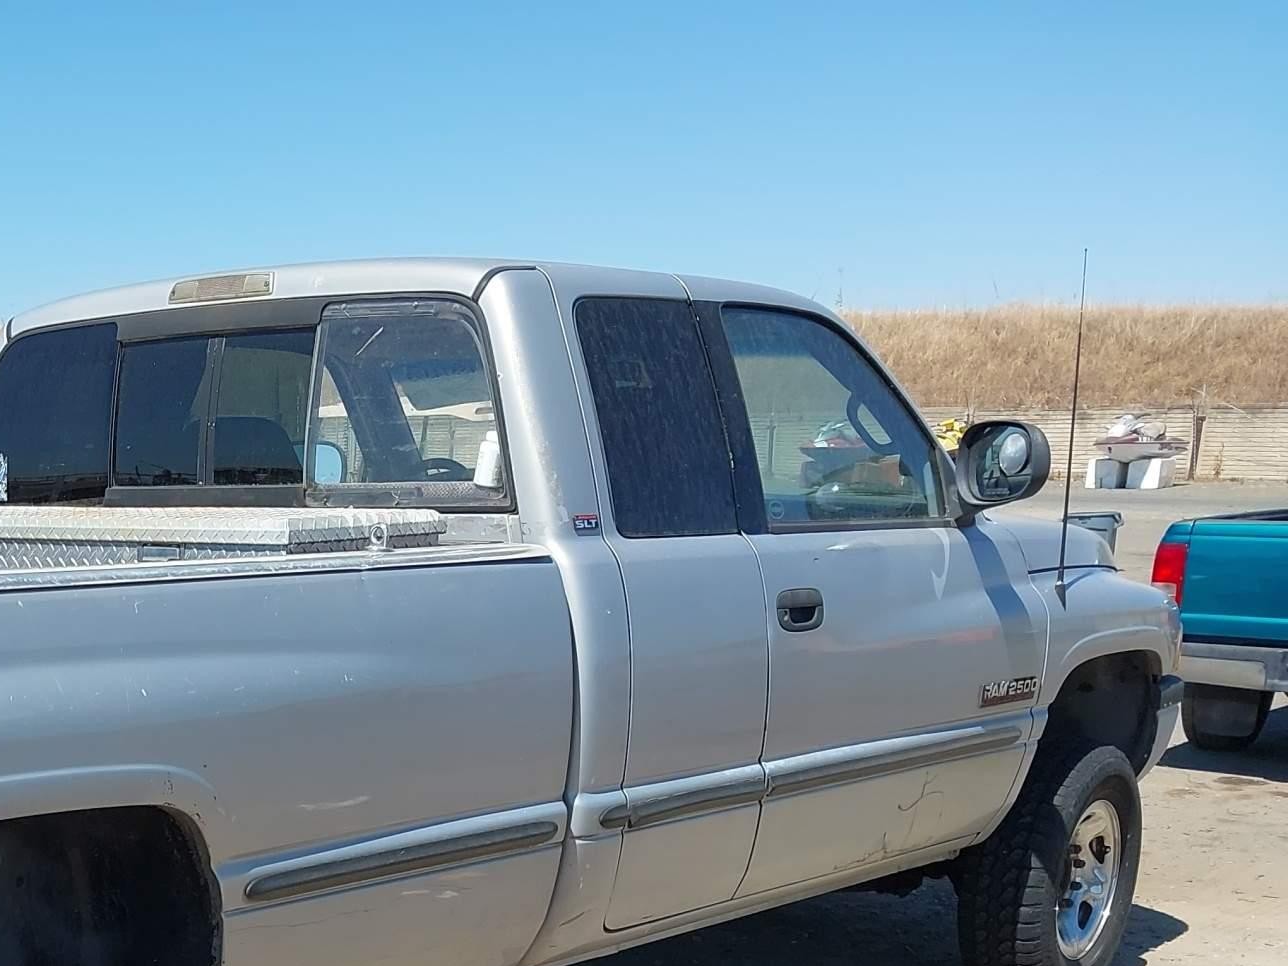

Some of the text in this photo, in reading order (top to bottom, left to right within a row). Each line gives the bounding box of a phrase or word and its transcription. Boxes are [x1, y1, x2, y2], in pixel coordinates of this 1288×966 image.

[575, 519, 597, 529] SLT
[983, 680, 1009, 701] RAM
[1007, 677, 1039, 696] 2500
